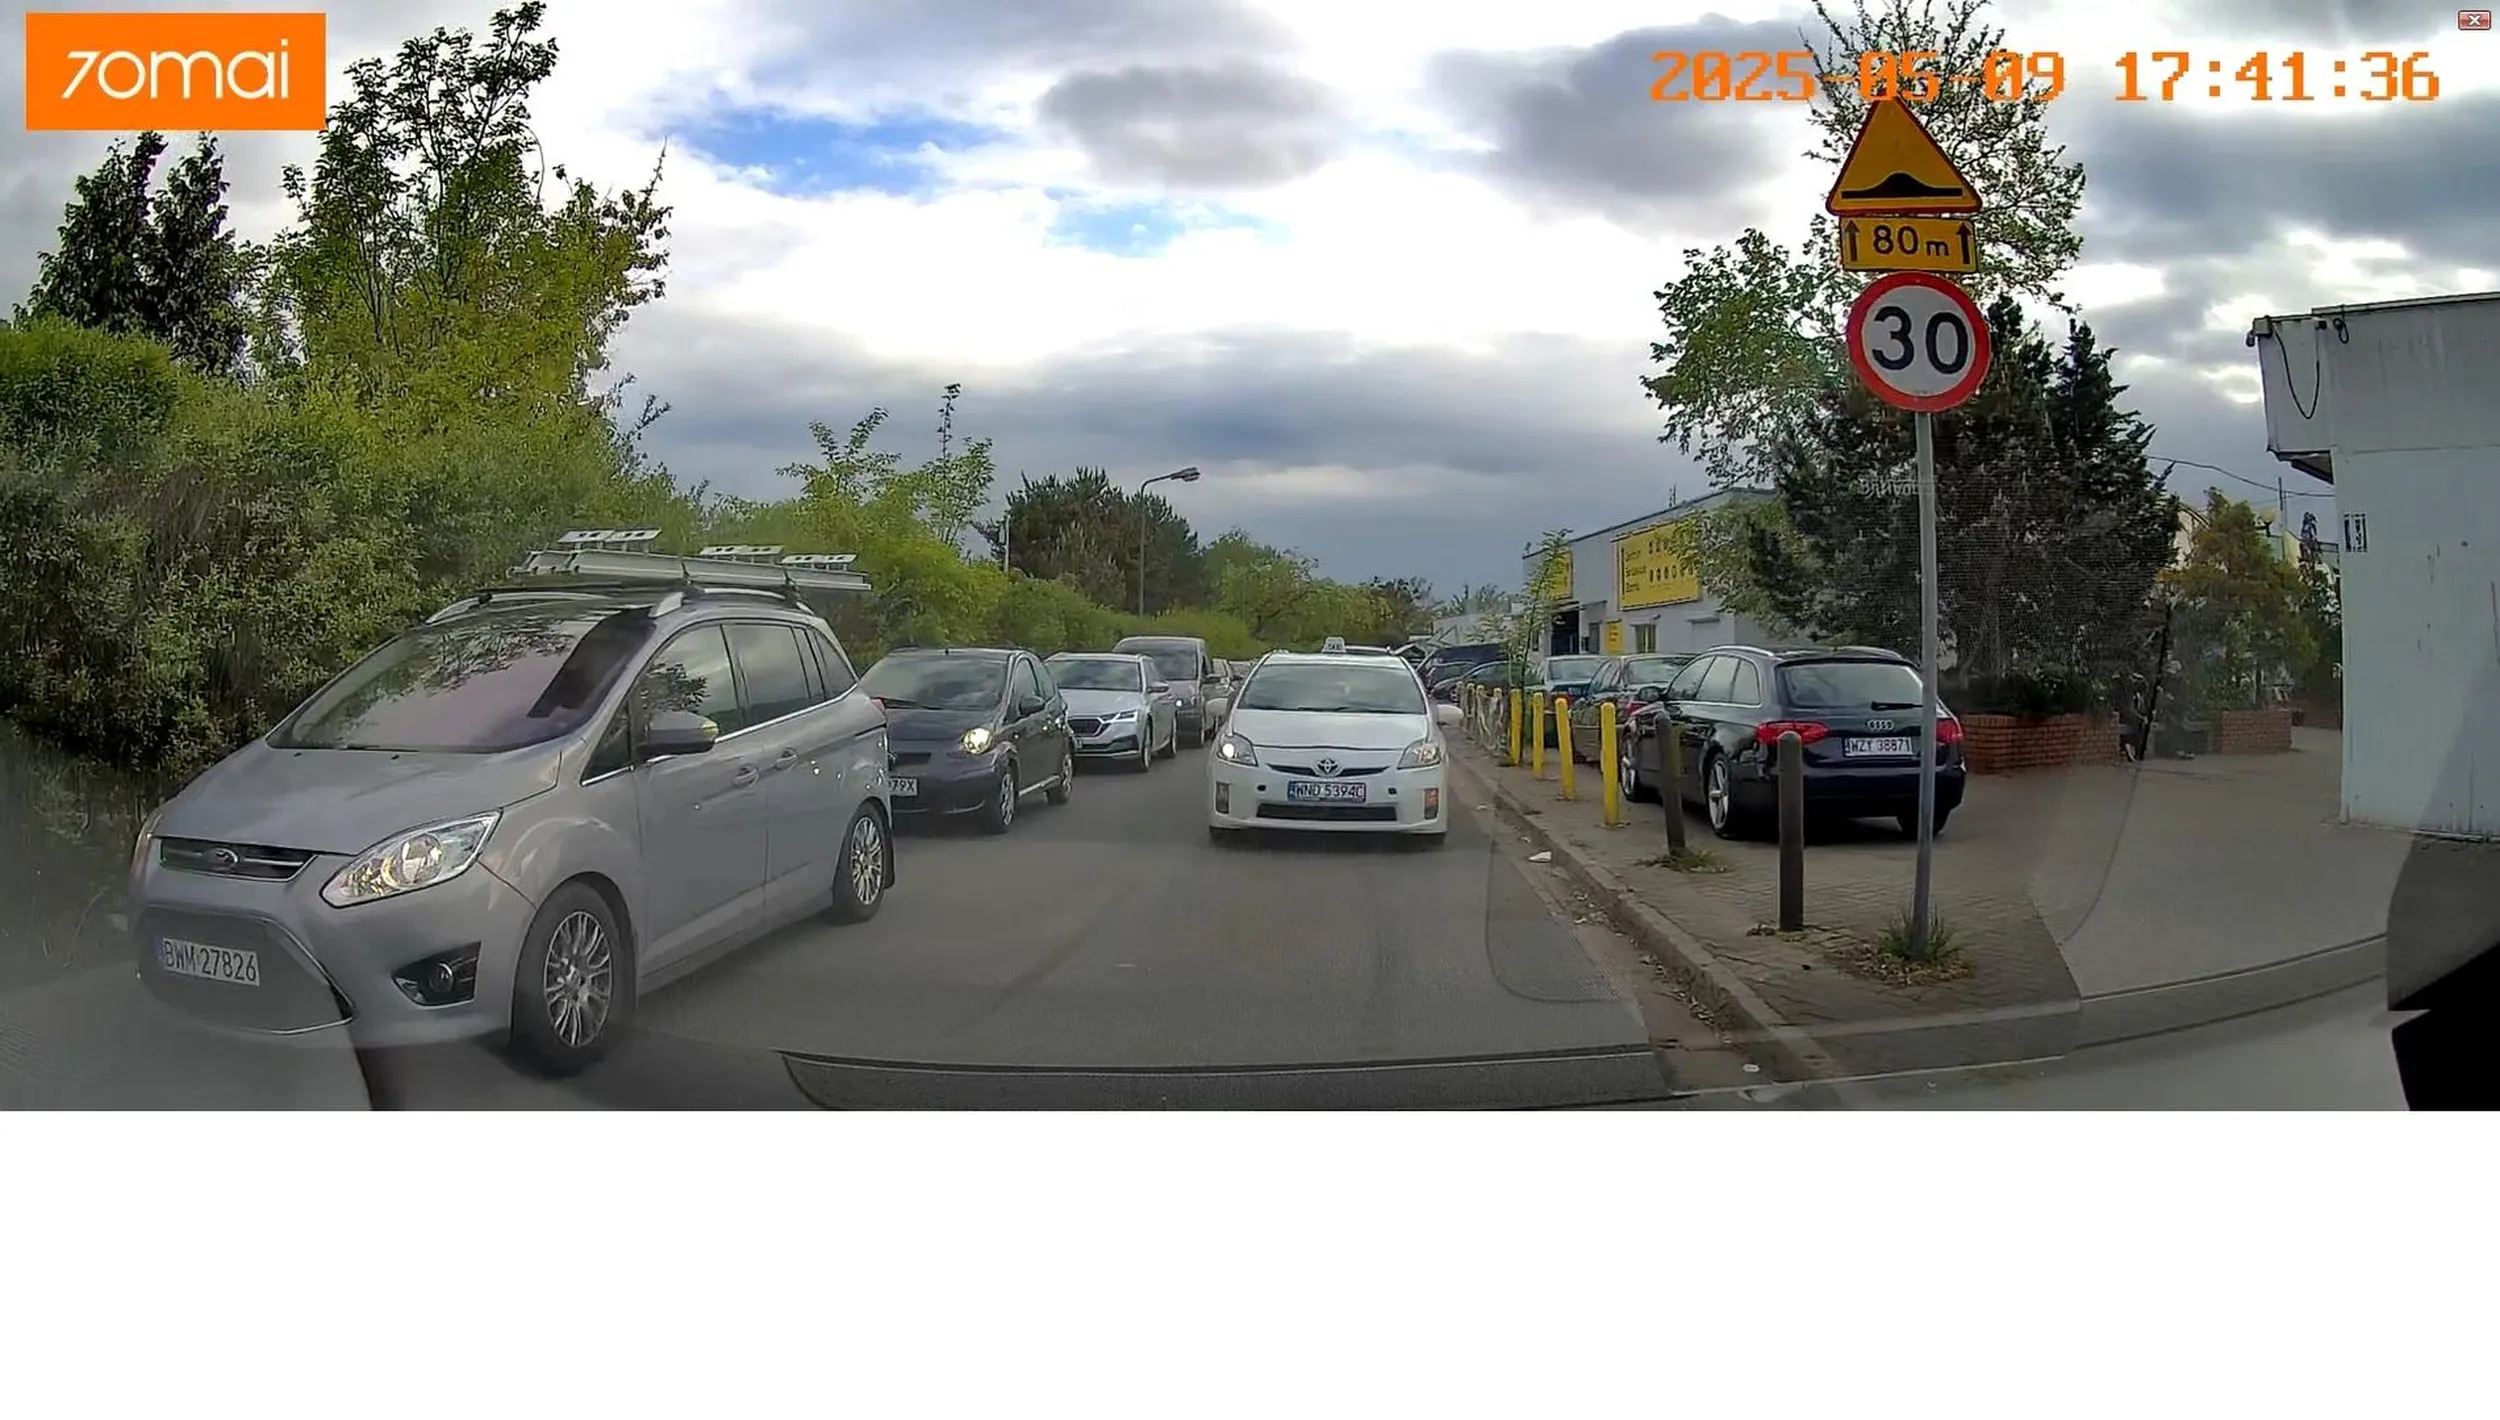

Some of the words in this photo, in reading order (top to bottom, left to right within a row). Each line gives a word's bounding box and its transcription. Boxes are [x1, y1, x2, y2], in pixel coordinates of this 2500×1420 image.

[1873, 224, 1919, 255] 80
[1925, 240, 1950, 257] m
[1871, 305, 1969, 375] 30
[164, 940, 197, 972] BWM
[199, 946, 257, 981] 27826
